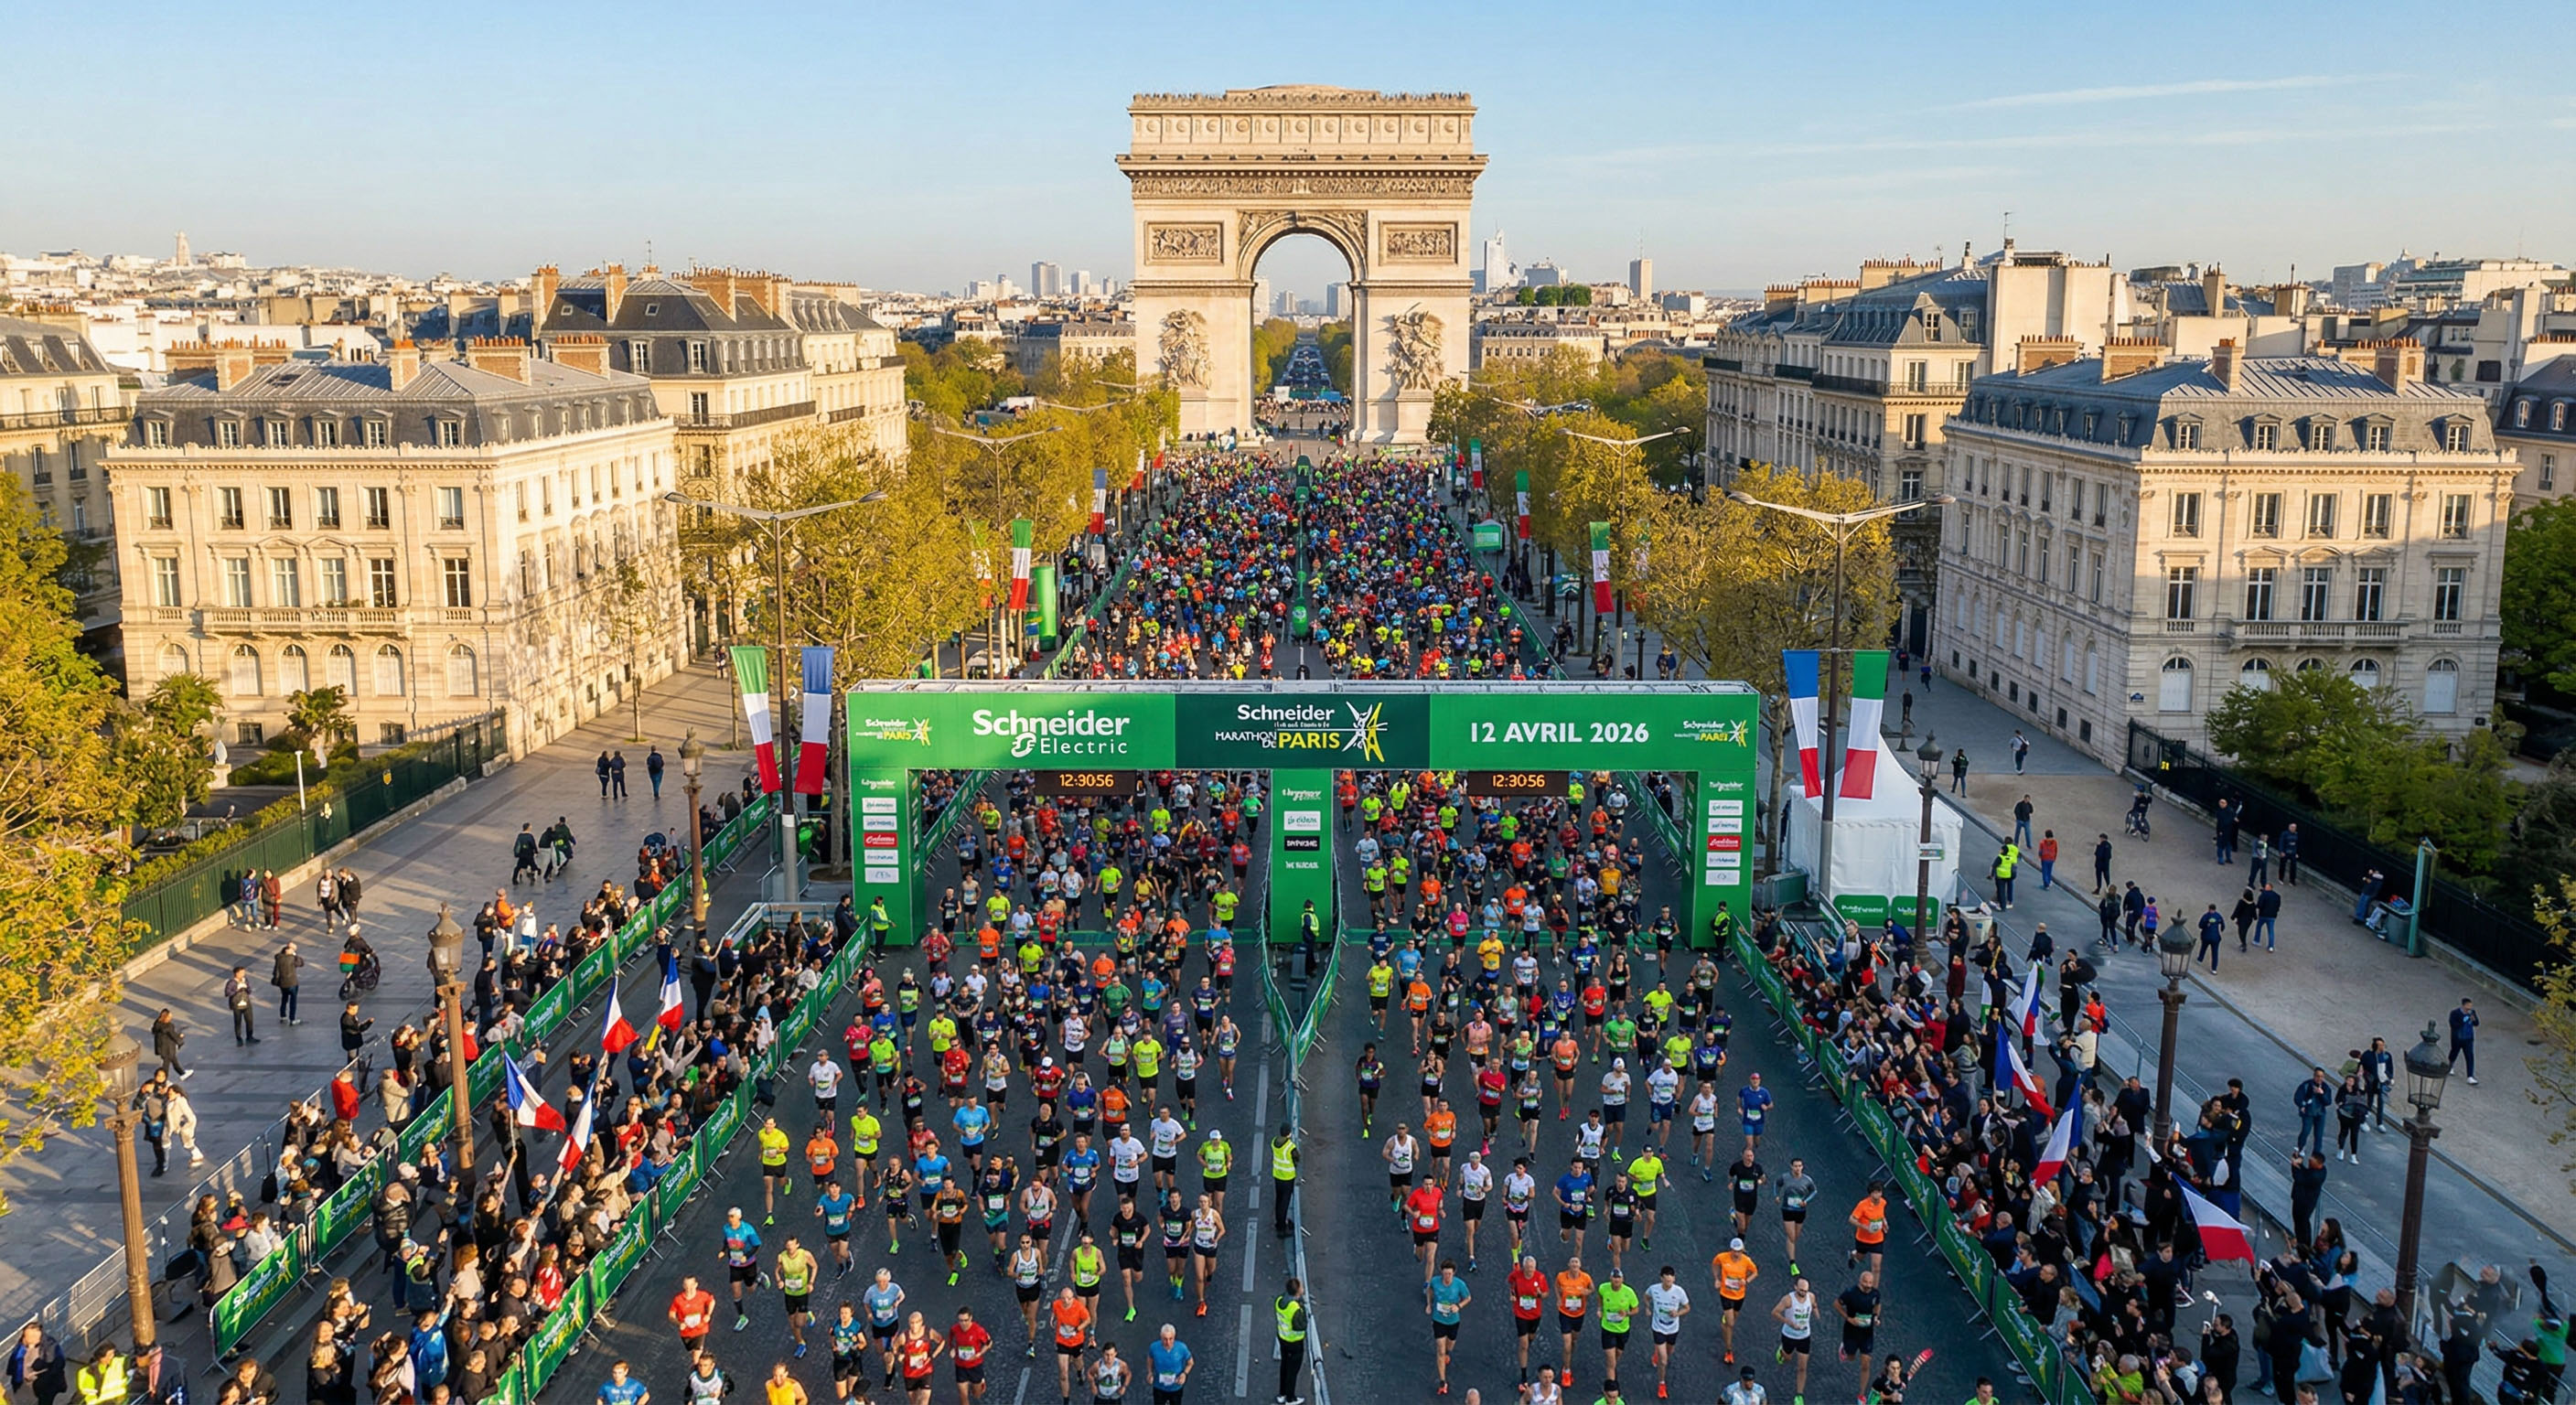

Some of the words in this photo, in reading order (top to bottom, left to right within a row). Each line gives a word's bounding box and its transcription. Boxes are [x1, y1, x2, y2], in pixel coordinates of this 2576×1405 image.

[972, 709, 1131, 735] Schneider
[1237, 704, 1335, 722] Schneider
[1215, 732, 1277, 741] MARATHON
[1278, 732, 1341, 749] PARIS
[1470, 723, 1497, 743] 12
[1503, 723, 1583, 743] AVRIL
[1590, 723, 1649, 744] 2026
[1040, 738, 1128, 754] Electric
